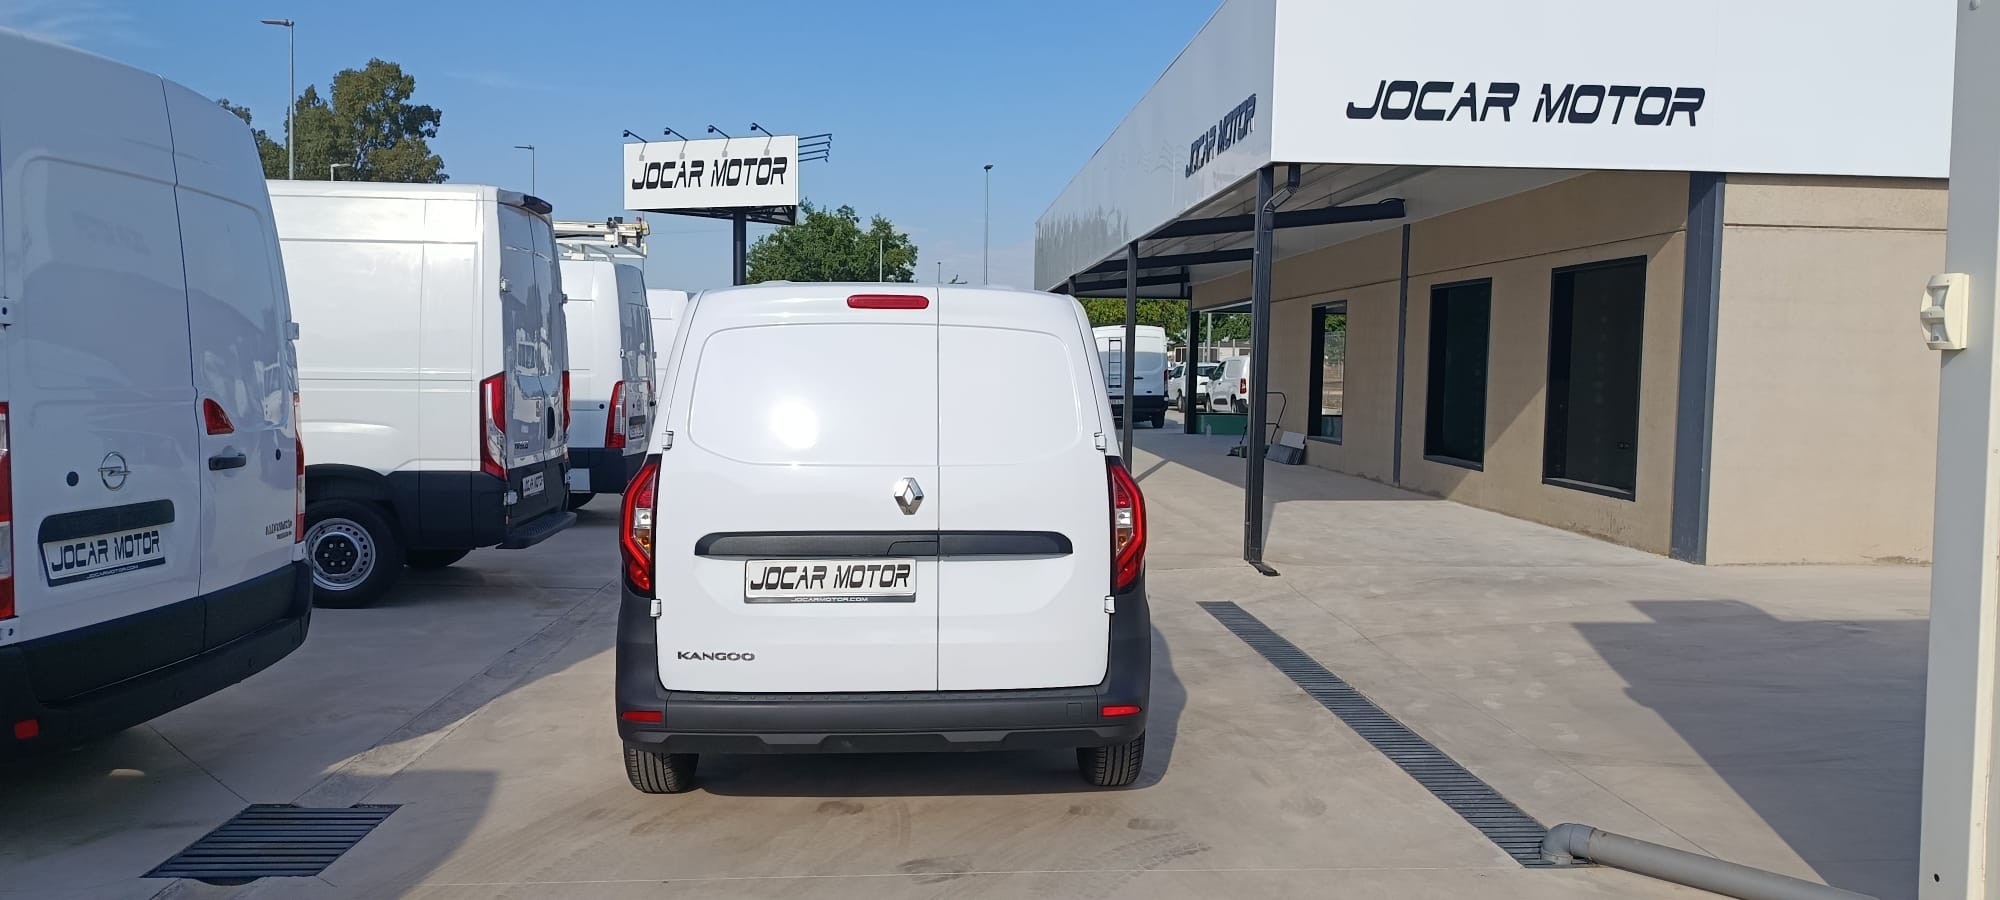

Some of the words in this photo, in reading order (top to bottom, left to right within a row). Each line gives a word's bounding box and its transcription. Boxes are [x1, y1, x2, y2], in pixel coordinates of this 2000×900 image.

[1346, 80, 1520, 122] JOCAR
[1532, 83, 1705, 127] MOTOR
[1185, 125, 1217, 178] JOCAR
[1217, 93, 1257, 155] MOTOR
[631, 160, 705, 190] JOCAR
[710, 157, 788, 187] MOTOR
[51, 539, 109, 572] JOCAR
[113, 530, 160, 561] MOTOR
[750, 566, 827, 590] JOCAR
[833, 564, 911, 589] MOTOR
[677, 651, 756, 661] KANGOO
